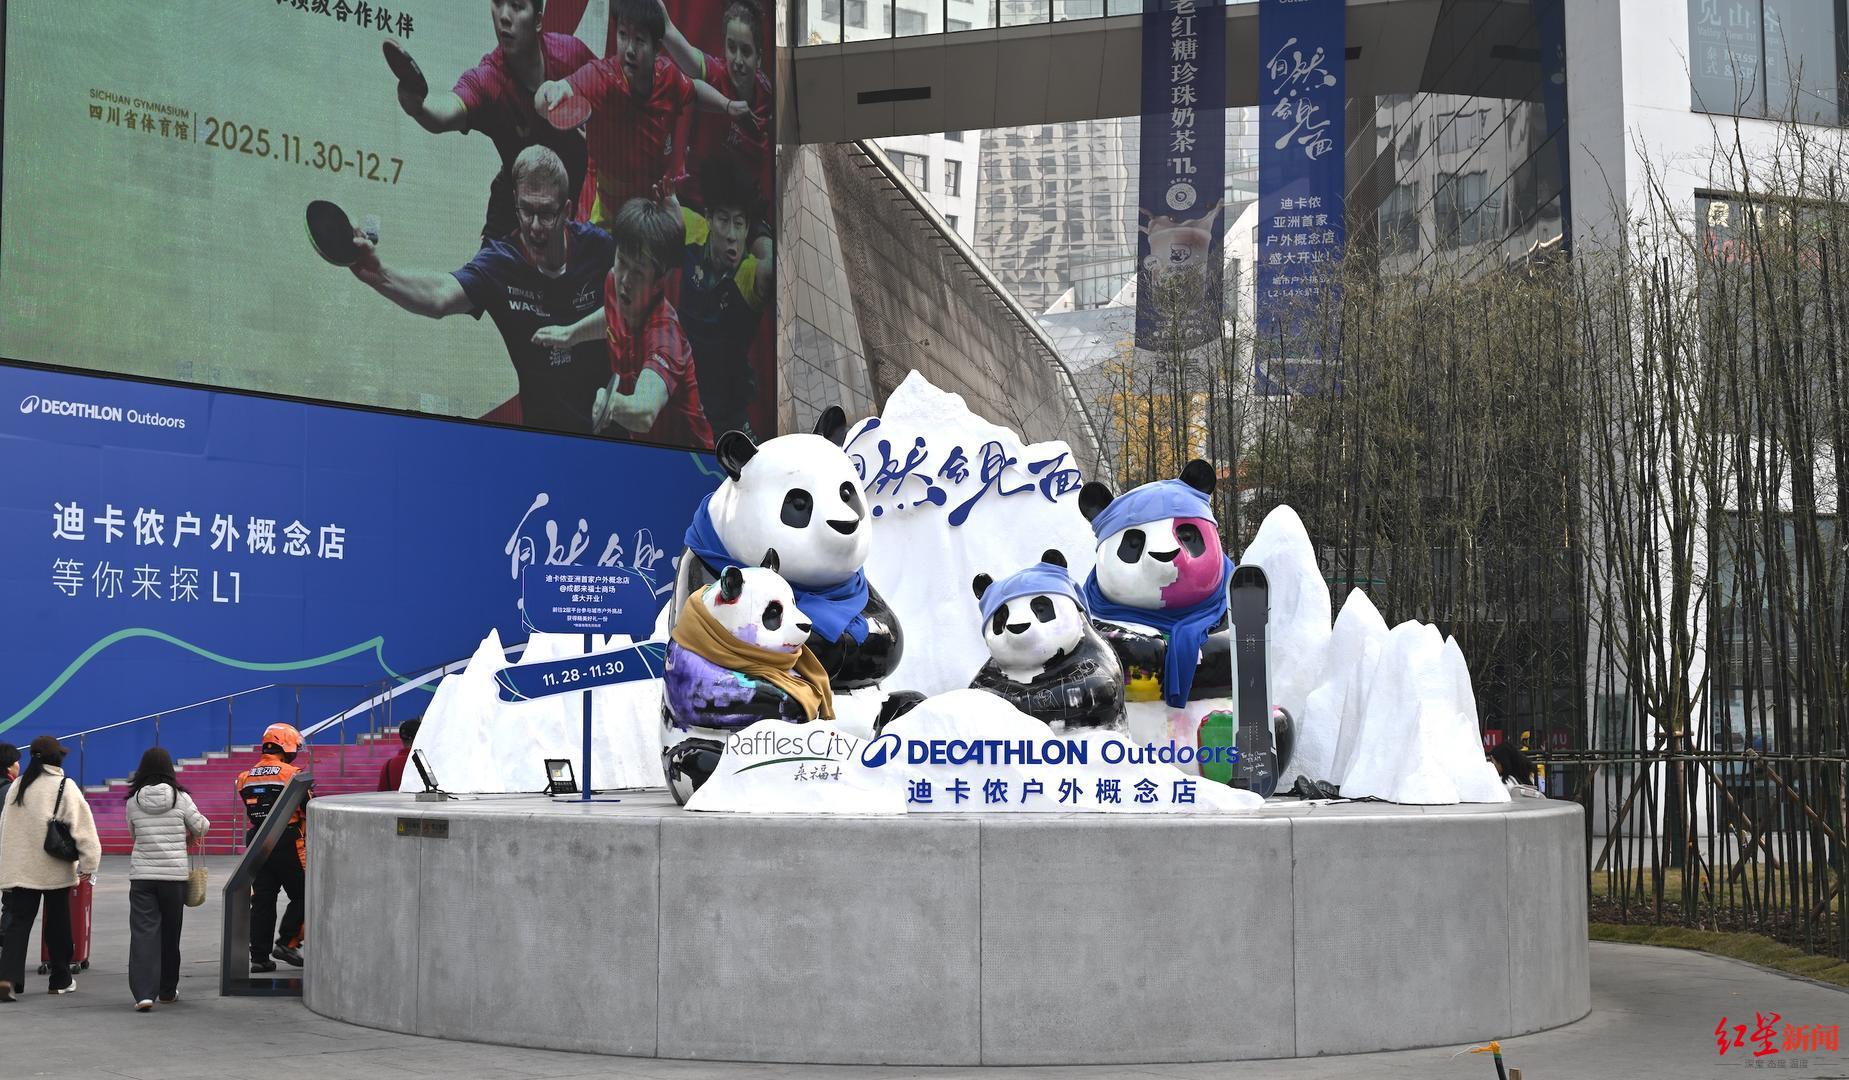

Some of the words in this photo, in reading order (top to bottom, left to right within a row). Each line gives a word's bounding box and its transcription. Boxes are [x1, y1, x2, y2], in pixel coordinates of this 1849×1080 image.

[277, 0, 414, 39] 级合作伙伴
[1724, 49, 1775, 65] Masse
[89, 88, 131, 106] SICHUAN
[133, 98, 189, 119] GYMNASIUM
[89, 104, 189, 141] 四川省体育馆
[205, 117, 403, 185] 2025.11.30-12.7
[1280, 196, 1321, 210] 迪卡侬
[1273, 213, 1328, 228] 亚洲首家
[1265, 229, 1335, 247] 户外概念店
[41, 398, 122, 422] DECATHLON
[127, 409, 186, 429] Outdoors
[52, 502, 346, 560] 迪卡侬户外概念店
[545, 574, 630, 584] 迪卡侬亚洲首家户外概念店
[559, 584, 616, 593] @成都来福士商场
[726, 730, 804, 756] Raffles
[807, 730, 859, 761] City
[908, 739, 1088, 765] DECATHLON
[1101, 739, 1241, 765] Outdoors
[794, 763, 843, 782] 来福士
[907, 777, 1198, 804] 迪卡侬户外概念店
